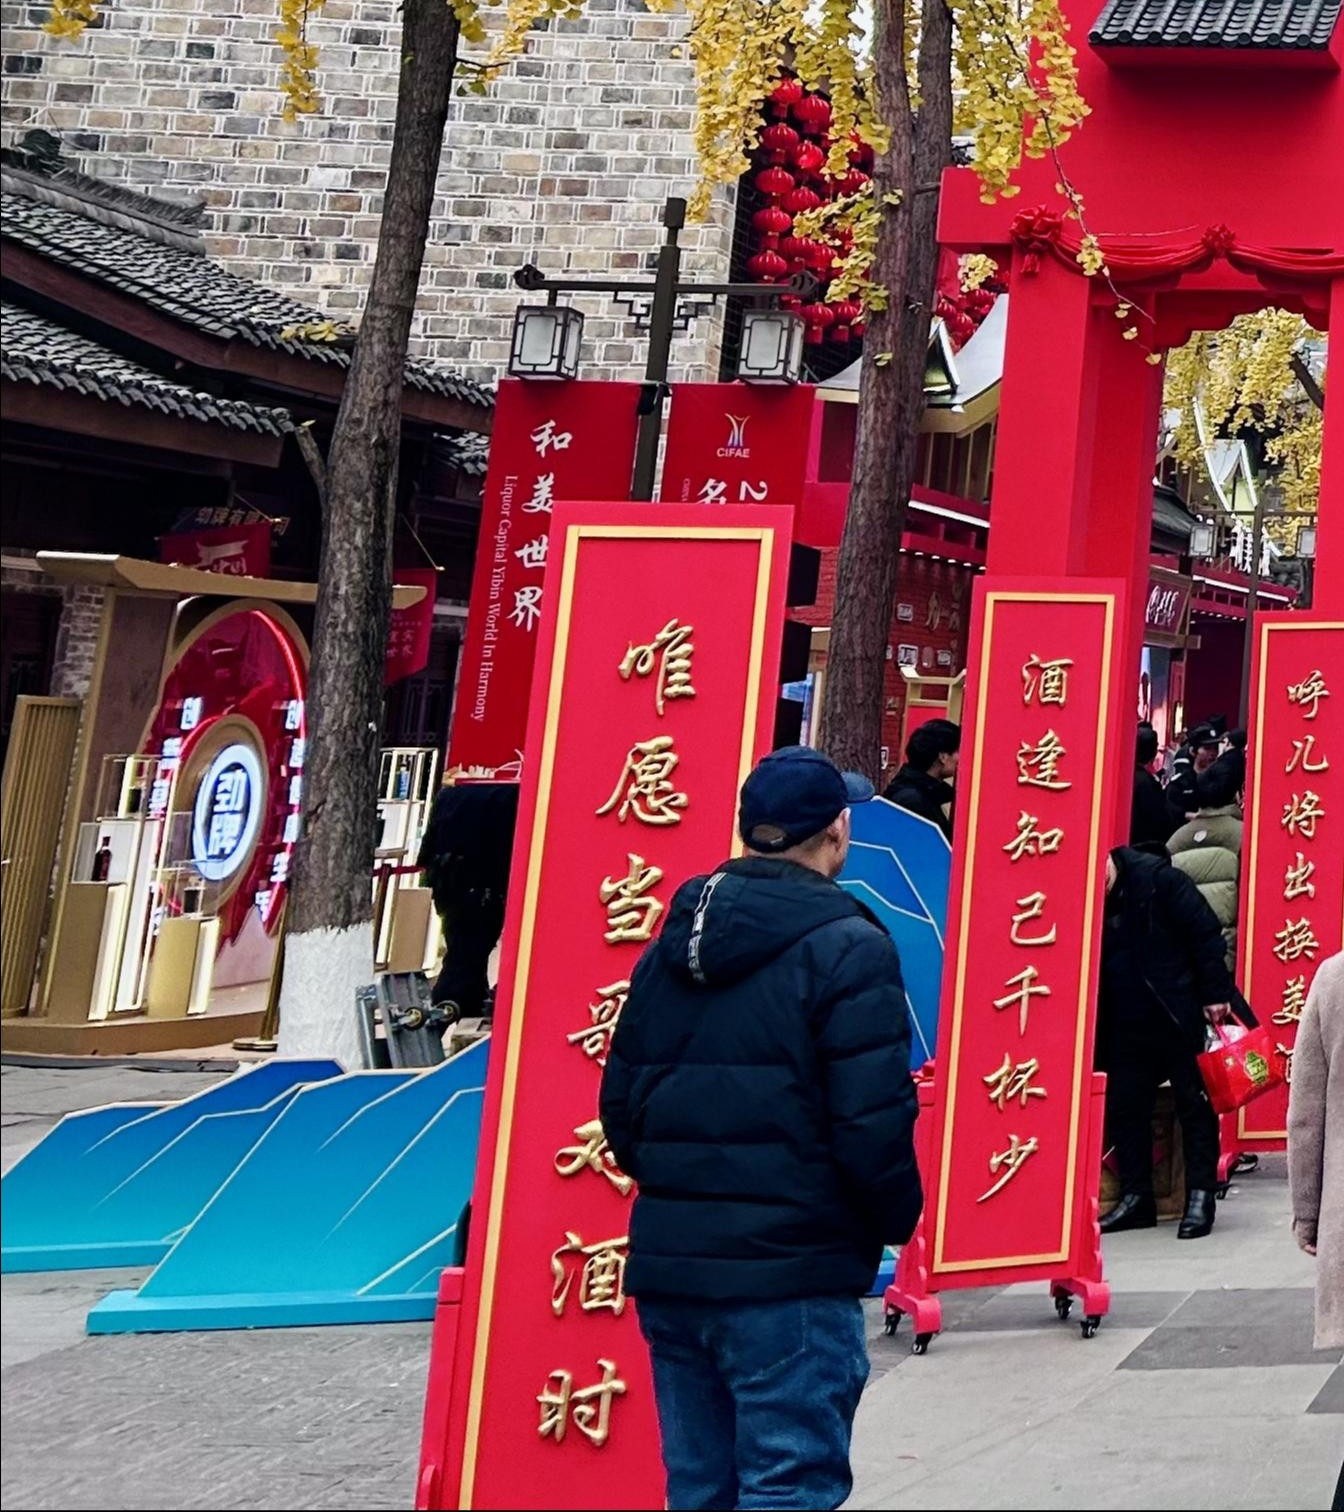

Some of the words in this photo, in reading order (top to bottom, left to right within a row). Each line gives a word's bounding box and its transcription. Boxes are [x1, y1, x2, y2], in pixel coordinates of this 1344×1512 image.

[716, 447, 751, 458] CIFAE
[499, 475, 518, 517] Liquor
[493, 519, 512, 563] Capital
[506, 419, 573, 633] 和美世界
[489, 566, 506, 600] Yibin
[483, 603, 501, 641] World
[482, 644, 496, 658] In
[471, 661, 494, 722] Harmony
[976, 651, 1074, 1203] 酒逢知己千杯少
